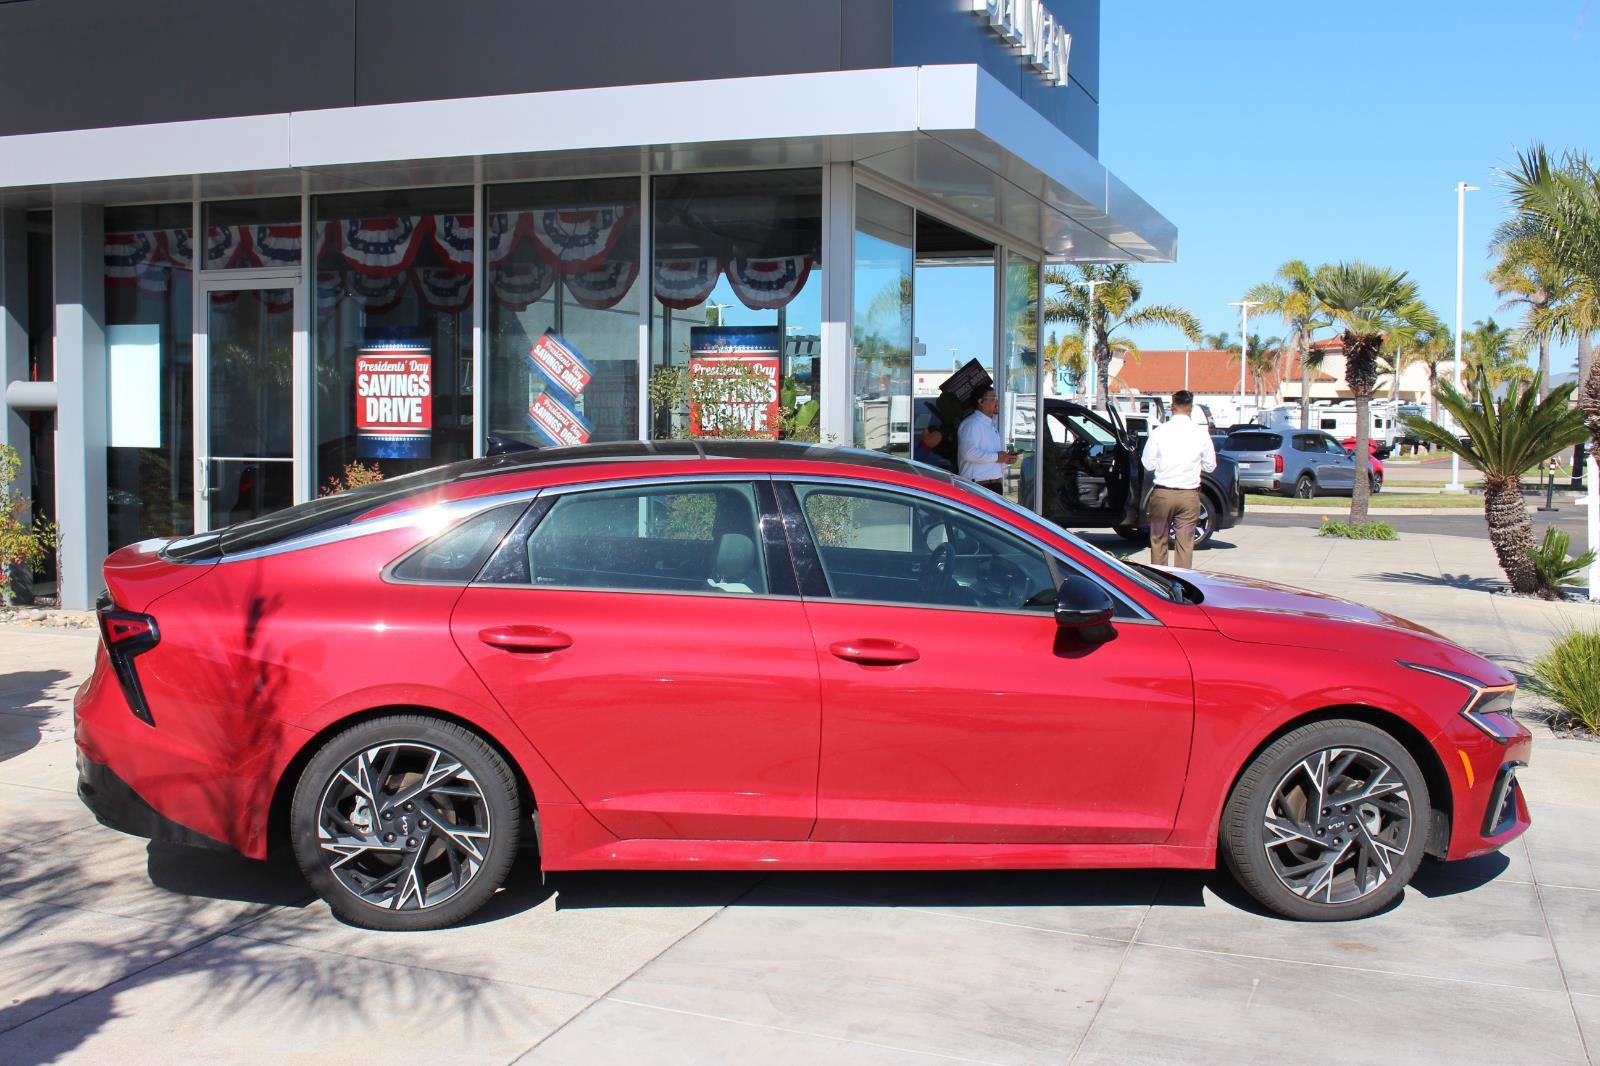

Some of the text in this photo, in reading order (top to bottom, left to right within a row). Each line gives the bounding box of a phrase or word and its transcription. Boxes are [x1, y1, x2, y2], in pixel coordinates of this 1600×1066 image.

[972, 0, 1071, 87] LIVERY
[359, 360, 429, 375] Presidents' Day
[533, 344, 584, 393] SAVINGS DRIVE
[753, 363, 776, 379] Day
[358, 374, 430, 397] SAVINGS
[366, 397, 423, 423] DRIVE
[533, 402, 581, 445] SAVINGS DRIV
